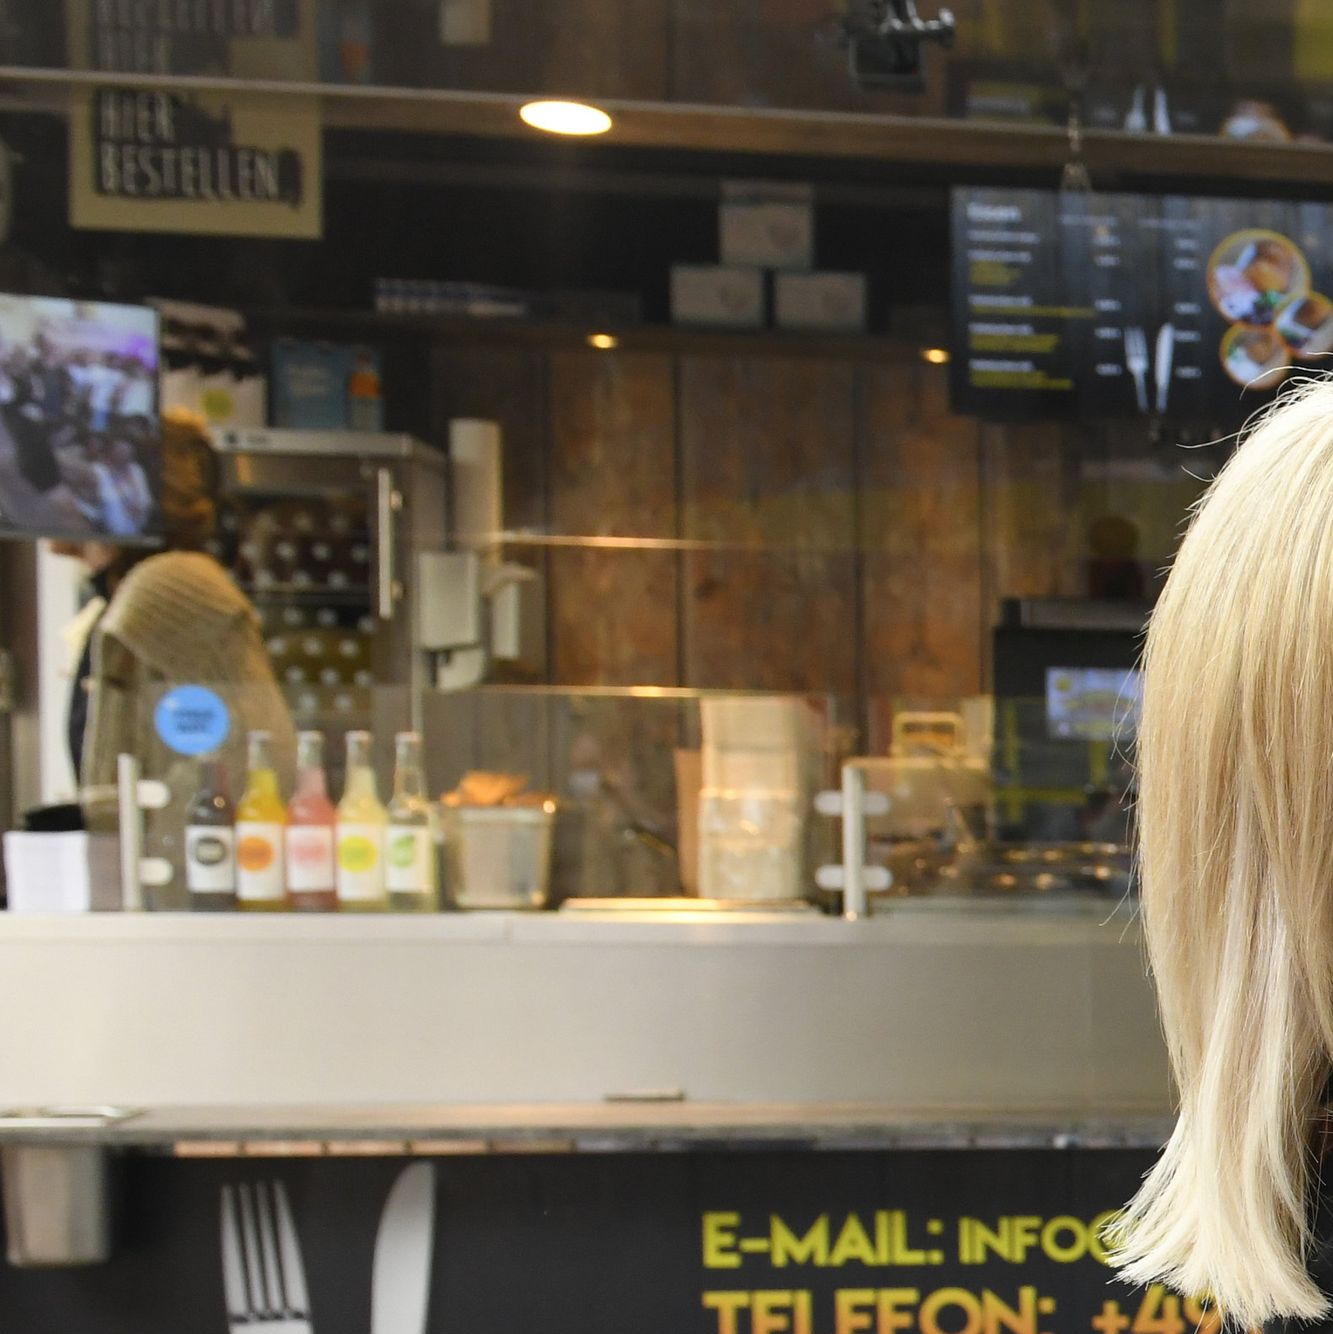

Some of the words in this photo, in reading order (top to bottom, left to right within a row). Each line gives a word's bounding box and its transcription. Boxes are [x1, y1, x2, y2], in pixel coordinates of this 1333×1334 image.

[100, 88, 176, 143] HIER
[100, 142, 278, 200] BESTELLEN
[702, 1210, 944, 1268] E-MAIL:
